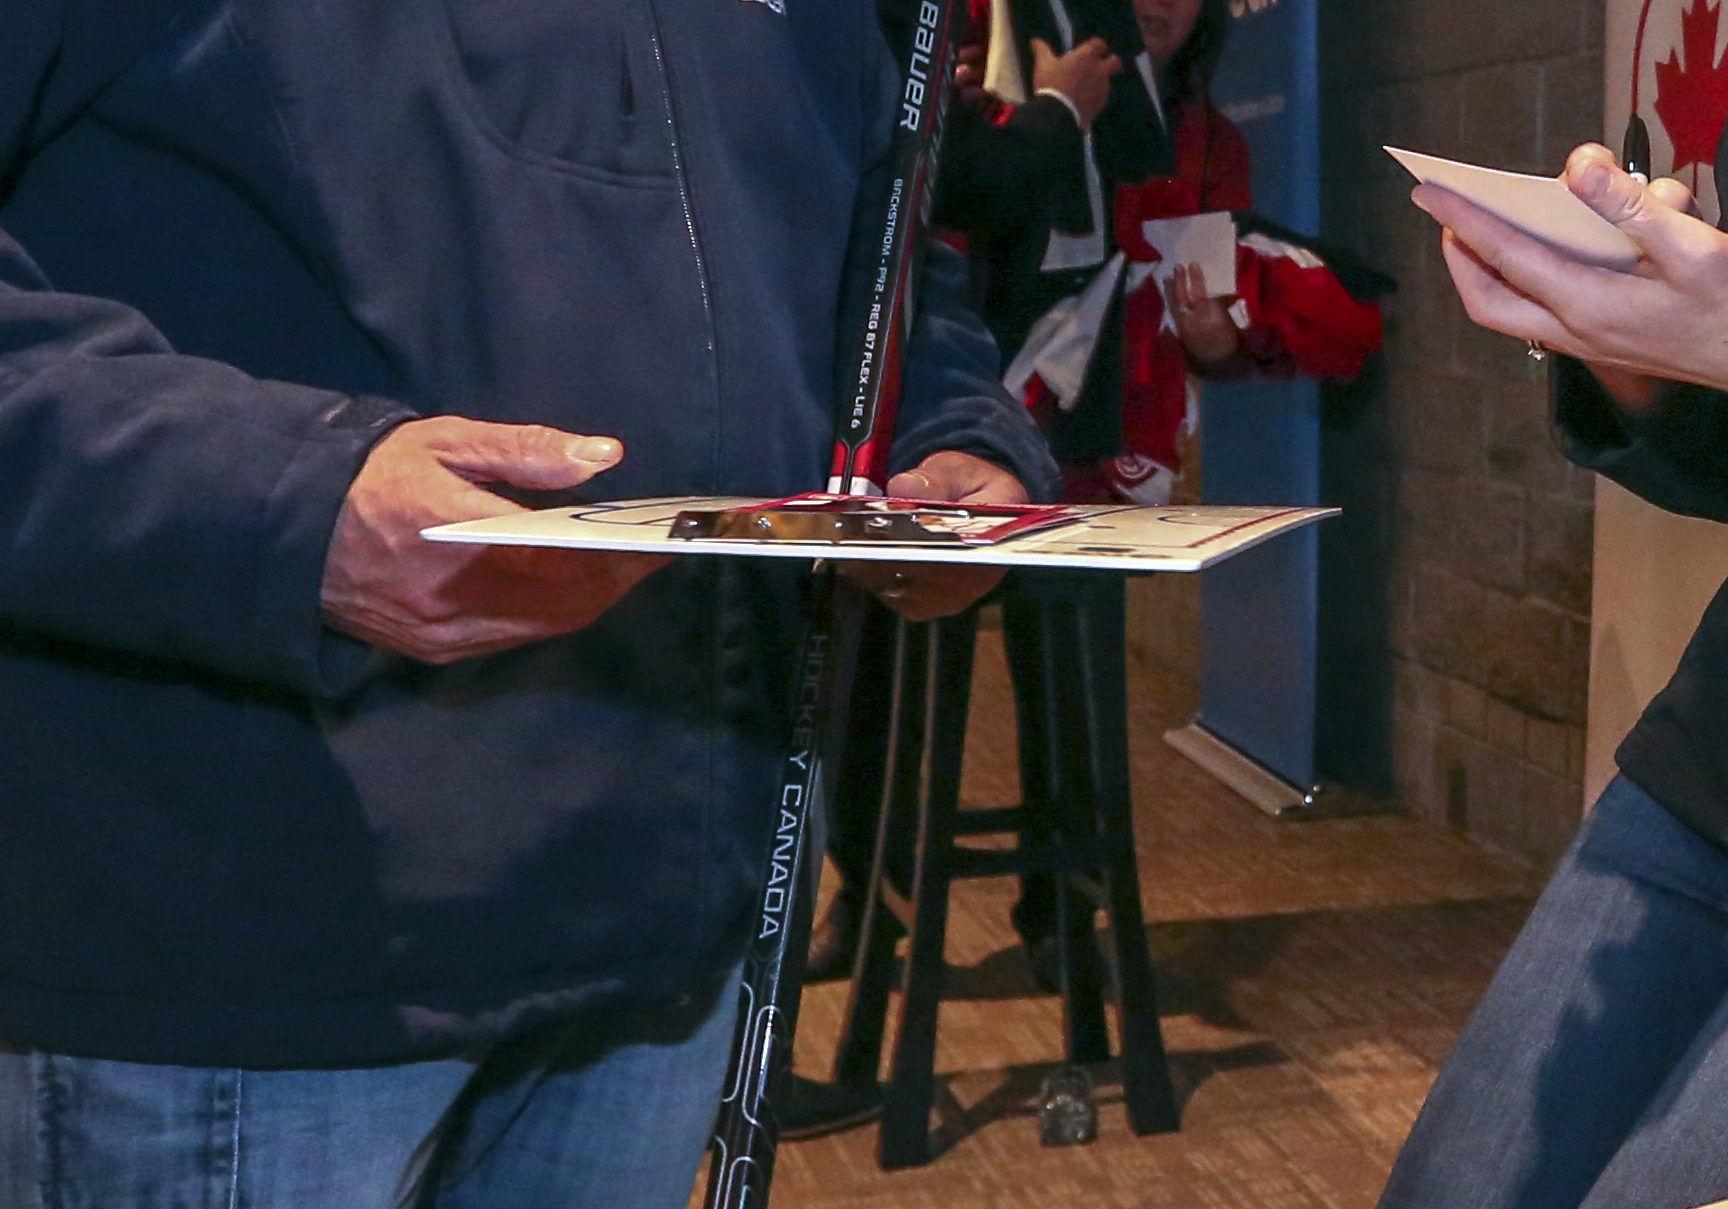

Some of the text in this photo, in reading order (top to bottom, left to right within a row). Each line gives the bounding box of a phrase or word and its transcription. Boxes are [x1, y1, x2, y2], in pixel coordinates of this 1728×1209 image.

[899, 0, 939, 132] BAUER
[881, 178, 903, 256] BACKSTROM
[867, 303, 881, 330] REG
[858, 352, 873, 385] FLEX
[853, 396, 866, 417] LIE
[850, 418, 861, 429] 6
[758, 635, 828, 940] HOCKEY CANADA
